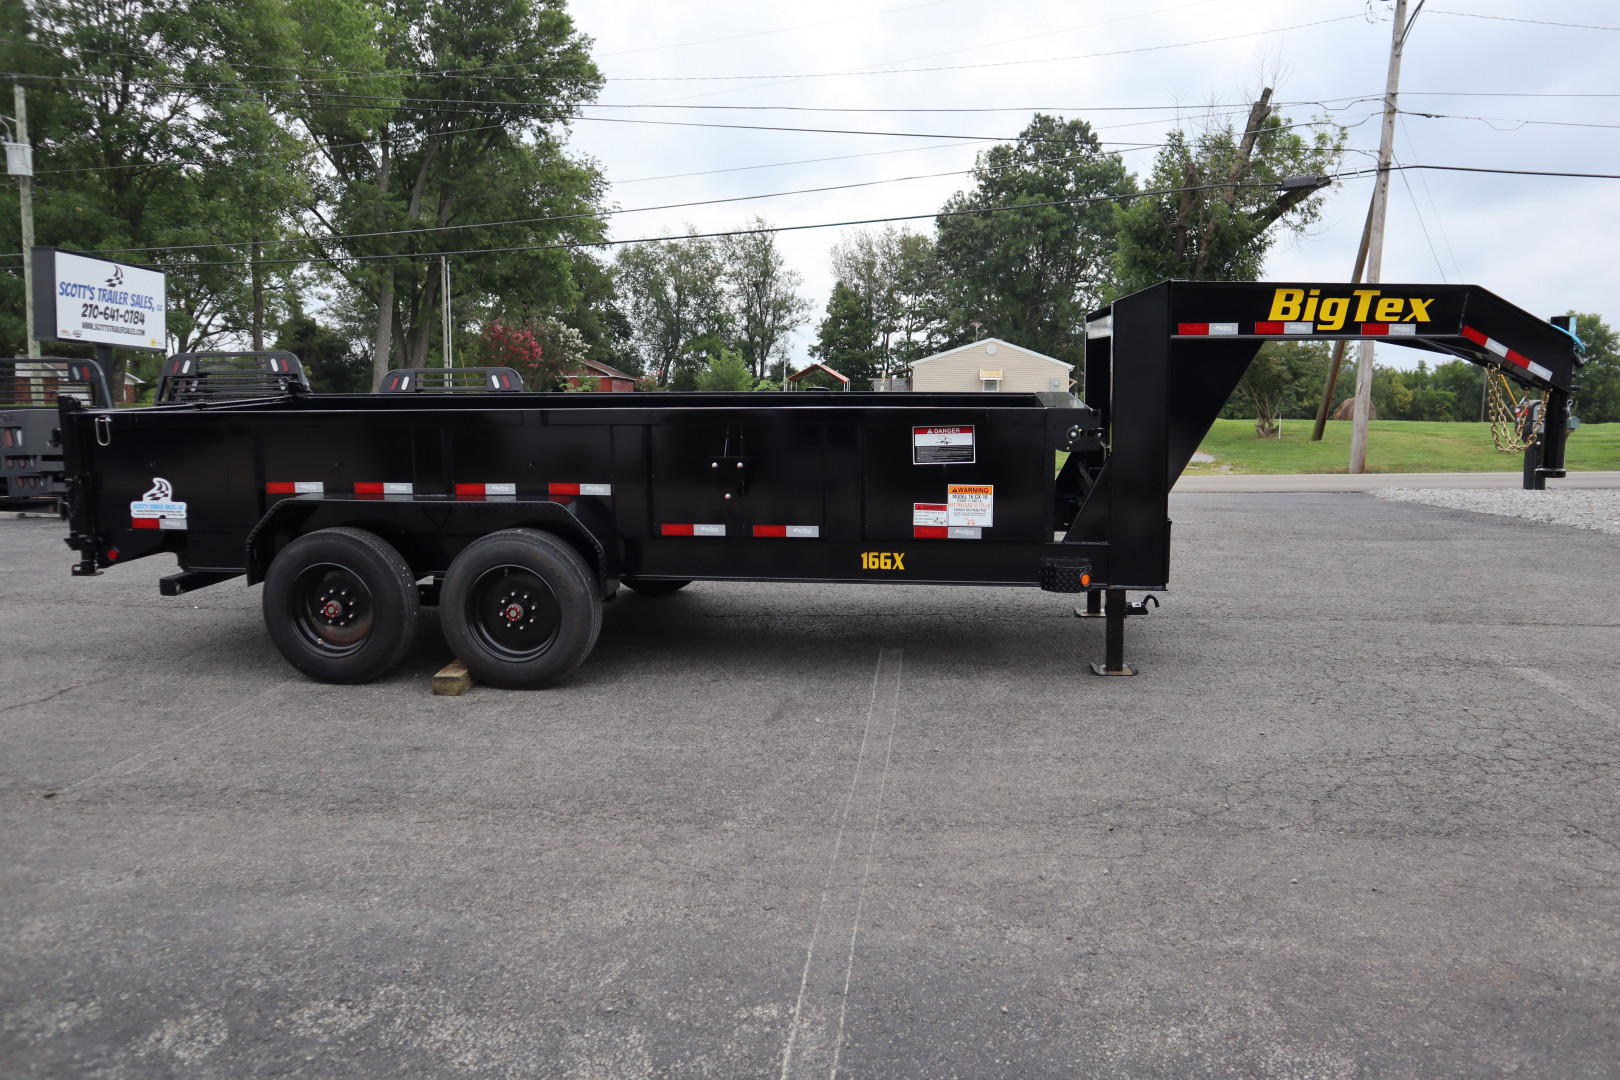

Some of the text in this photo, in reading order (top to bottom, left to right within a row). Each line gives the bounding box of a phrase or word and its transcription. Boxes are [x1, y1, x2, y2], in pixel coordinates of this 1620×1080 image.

[59, 282, 96, 300] SCOTT'S
[98, 288, 128, 304] TRAILER
[130, 294, 154, 312] SALES,
[1267, 288, 1435, 331] BigTex
[81, 303, 146, 325] 270-641-0784
[860, 551, 905, 570] 16GX
